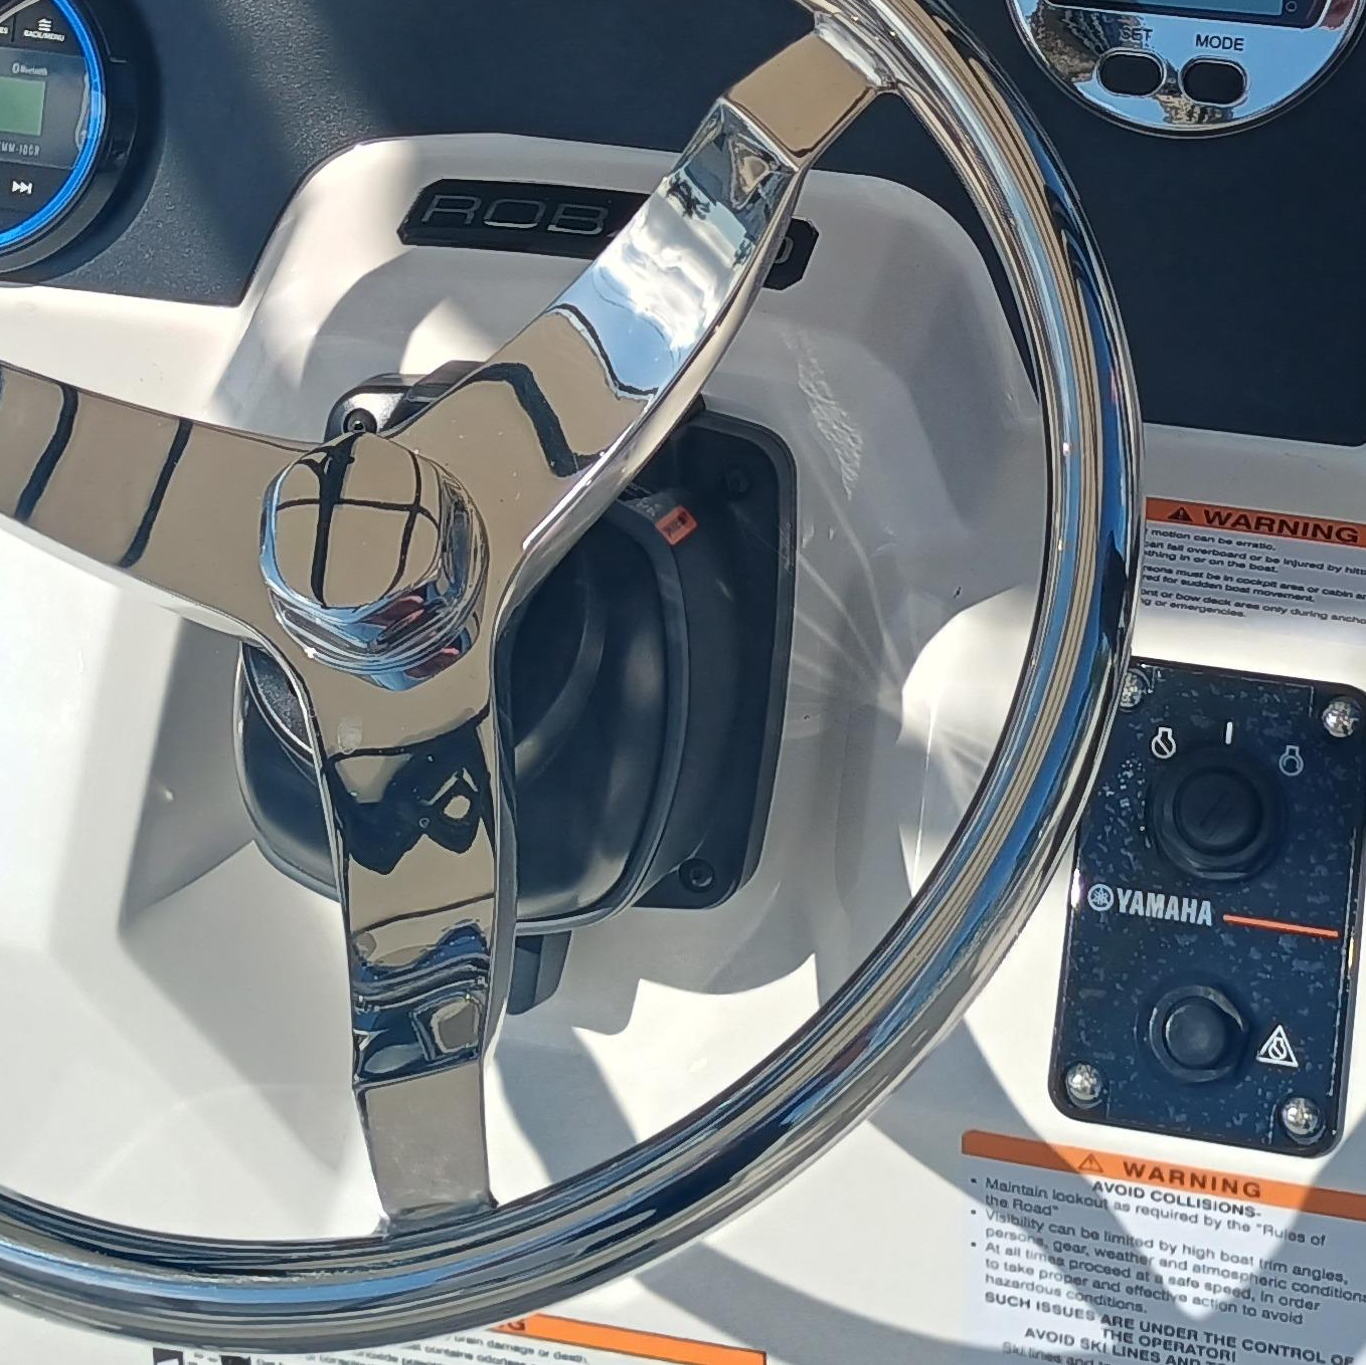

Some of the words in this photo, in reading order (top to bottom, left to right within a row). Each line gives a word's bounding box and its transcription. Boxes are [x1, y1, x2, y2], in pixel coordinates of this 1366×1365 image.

[1121, 27, 1153, 42] SET
[1195, 33, 1245, 52] MODE
[1203, 509, 1359, 544] WARNING
[1187, 546, 1247, 560] overboard
[1236, 577, 1277, 589] cockpit
[1116, 887, 1213, 928] YAMAHA
[1092, 1181, 1146, 1199] AVOID
[1122, 1160, 1261, 1199] WARNING
[985, 1195, 1008, 1207] the
[985, 1177, 1048, 1200] Maintain
[1052, 1186, 1108, 1210] lookout
[1114, 1201, 1131, 1212] as
[1135, 1205, 1198, 1224] required
[1204, 1216, 1222, 1230] by
[1227, 1218, 1251, 1232] the
[1310, 1235, 1326, 1247] of
[986, 1210, 1044, 1232] Visibility
[1048, 1223, 1075, 1236] can
[1081, 1227, 1099, 1241] be
[1104, 1230, 1154, 1249] limited
[1159, 1240, 1177, 1254] by
[1182, 1243, 1215, 1260] high
[1220, 1250, 1254, 1266] boat
[1259, 1258, 1288, 1274] trim
[986, 1227, 1048, 1249] persons,
[1053, 1240, 1089, 1257] gear,
[1094, 1247, 1154, 1266] weather
[1159, 1257, 1187, 1271] and
[1192, 1264, 1287, 1289] atmospheric
[985, 1242, 1000, 1254] At
[1005, 1245, 1021, 1257] all
[1026, 1248, 1065, 1266] times
[1069, 1259, 1131, 1279] proceed
[1136, 1271, 1150, 1282] at
[1168, 1276, 1200, 1289] safe
[1204, 1283, 1255, 1303] speed,
[1279, 1295, 1320, 1310] order
[985, 1259, 1000, 1270] to
[1004, 1261, 1035, 1276] take
[1039, 1268, 1088, 1285] proper
[1092, 1279, 1121, 1293] and
[1125, 1283, 1188, 1303] effective
[1192, 1295, 1237, 1313] action
[1242, 1304, 1257, 1317] to
[1261, 1309, 1303, 1325] avoid
[985, 1274, 1061, 1297] hazardous
[1066, 1290, 1147, 1314] conditions.
[984, 1291, 1031, 1310] SUCH
[1036, 1302, 1095, 1322] ISSUES
[1101, 1314, 1135, 1330] ARE
[1139, 1320, 1198, 1342] UNDER
[1203, 1331, 1237, 1349] THE
[1242, 1338, 1326, 1365] CONTROL
[1331, 1354, 1354, 1365] OF
[1025, 1327, 1075, 1346] AVOID
[1080, 1337, 1107, 1353] SKI
[1112, 1344, 1161, 1363] LINES
[1101, 1328, 1133, 1344] THE
